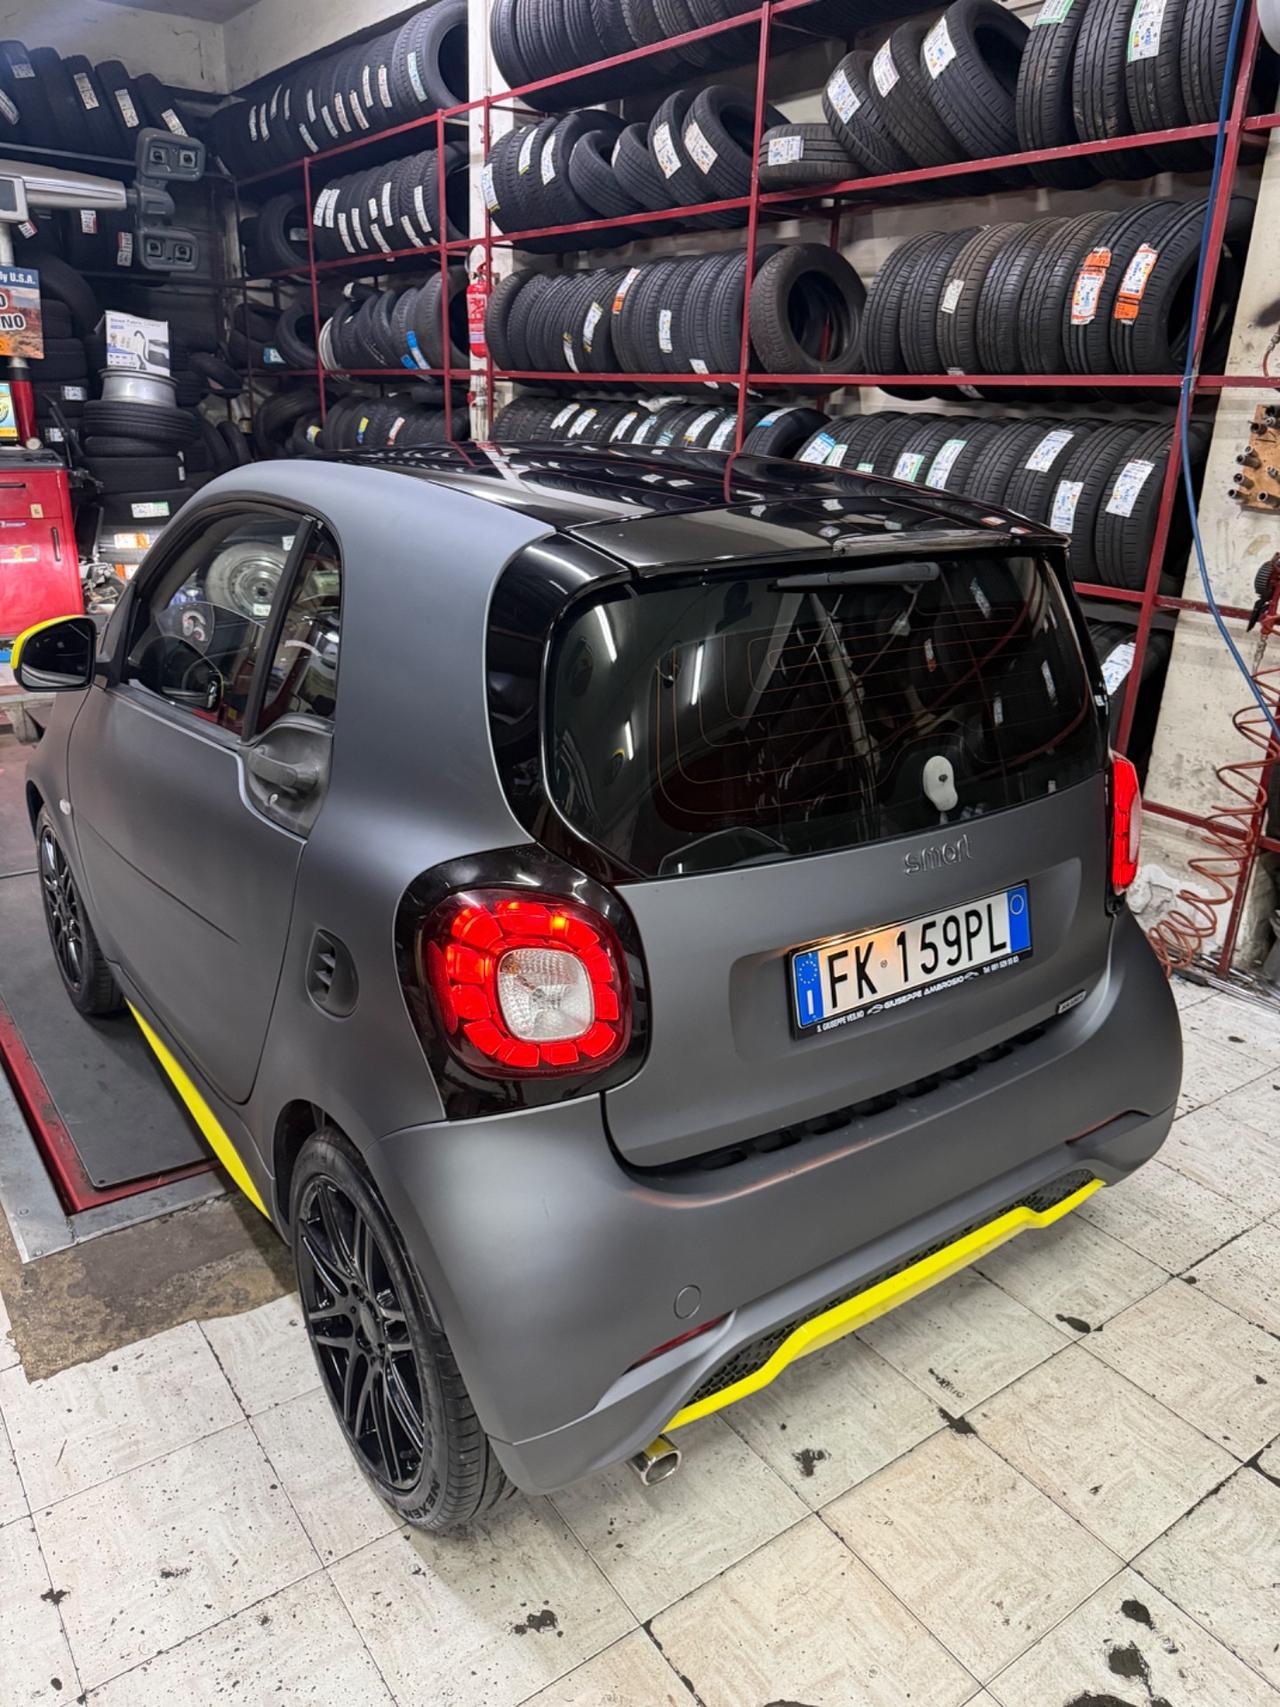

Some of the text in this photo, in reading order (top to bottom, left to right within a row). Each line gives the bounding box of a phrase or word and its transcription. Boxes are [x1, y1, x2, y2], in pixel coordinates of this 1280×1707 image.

[9, 271, 36, 285] U.S.A.
[904, 834, 973, 876] smart
[827, 902, 1008, 1009] FK 159PL
[883, 975, 965, 1009] GIUSEPPE AMBROSIO
[401, 1479, 440, 1519] NEXEN
